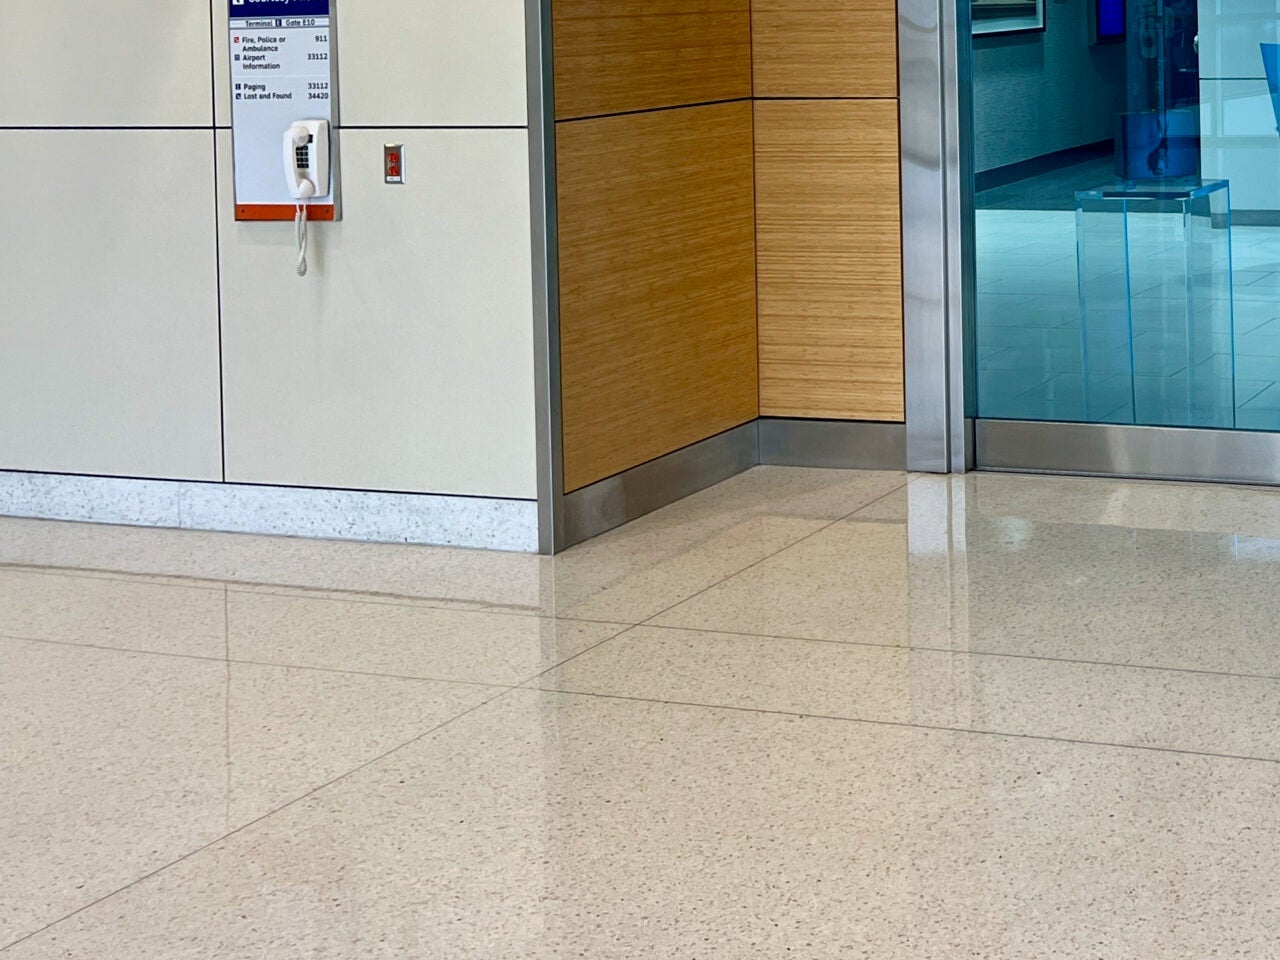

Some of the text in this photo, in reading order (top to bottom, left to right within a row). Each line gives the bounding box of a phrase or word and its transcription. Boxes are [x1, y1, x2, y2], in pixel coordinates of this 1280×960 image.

[245, 20, 273, 28] Terminal
[242, 54, 266, 62] Airport
[243, 84, 266, 92] Paging
[308, 92, 329, 100] 34420
